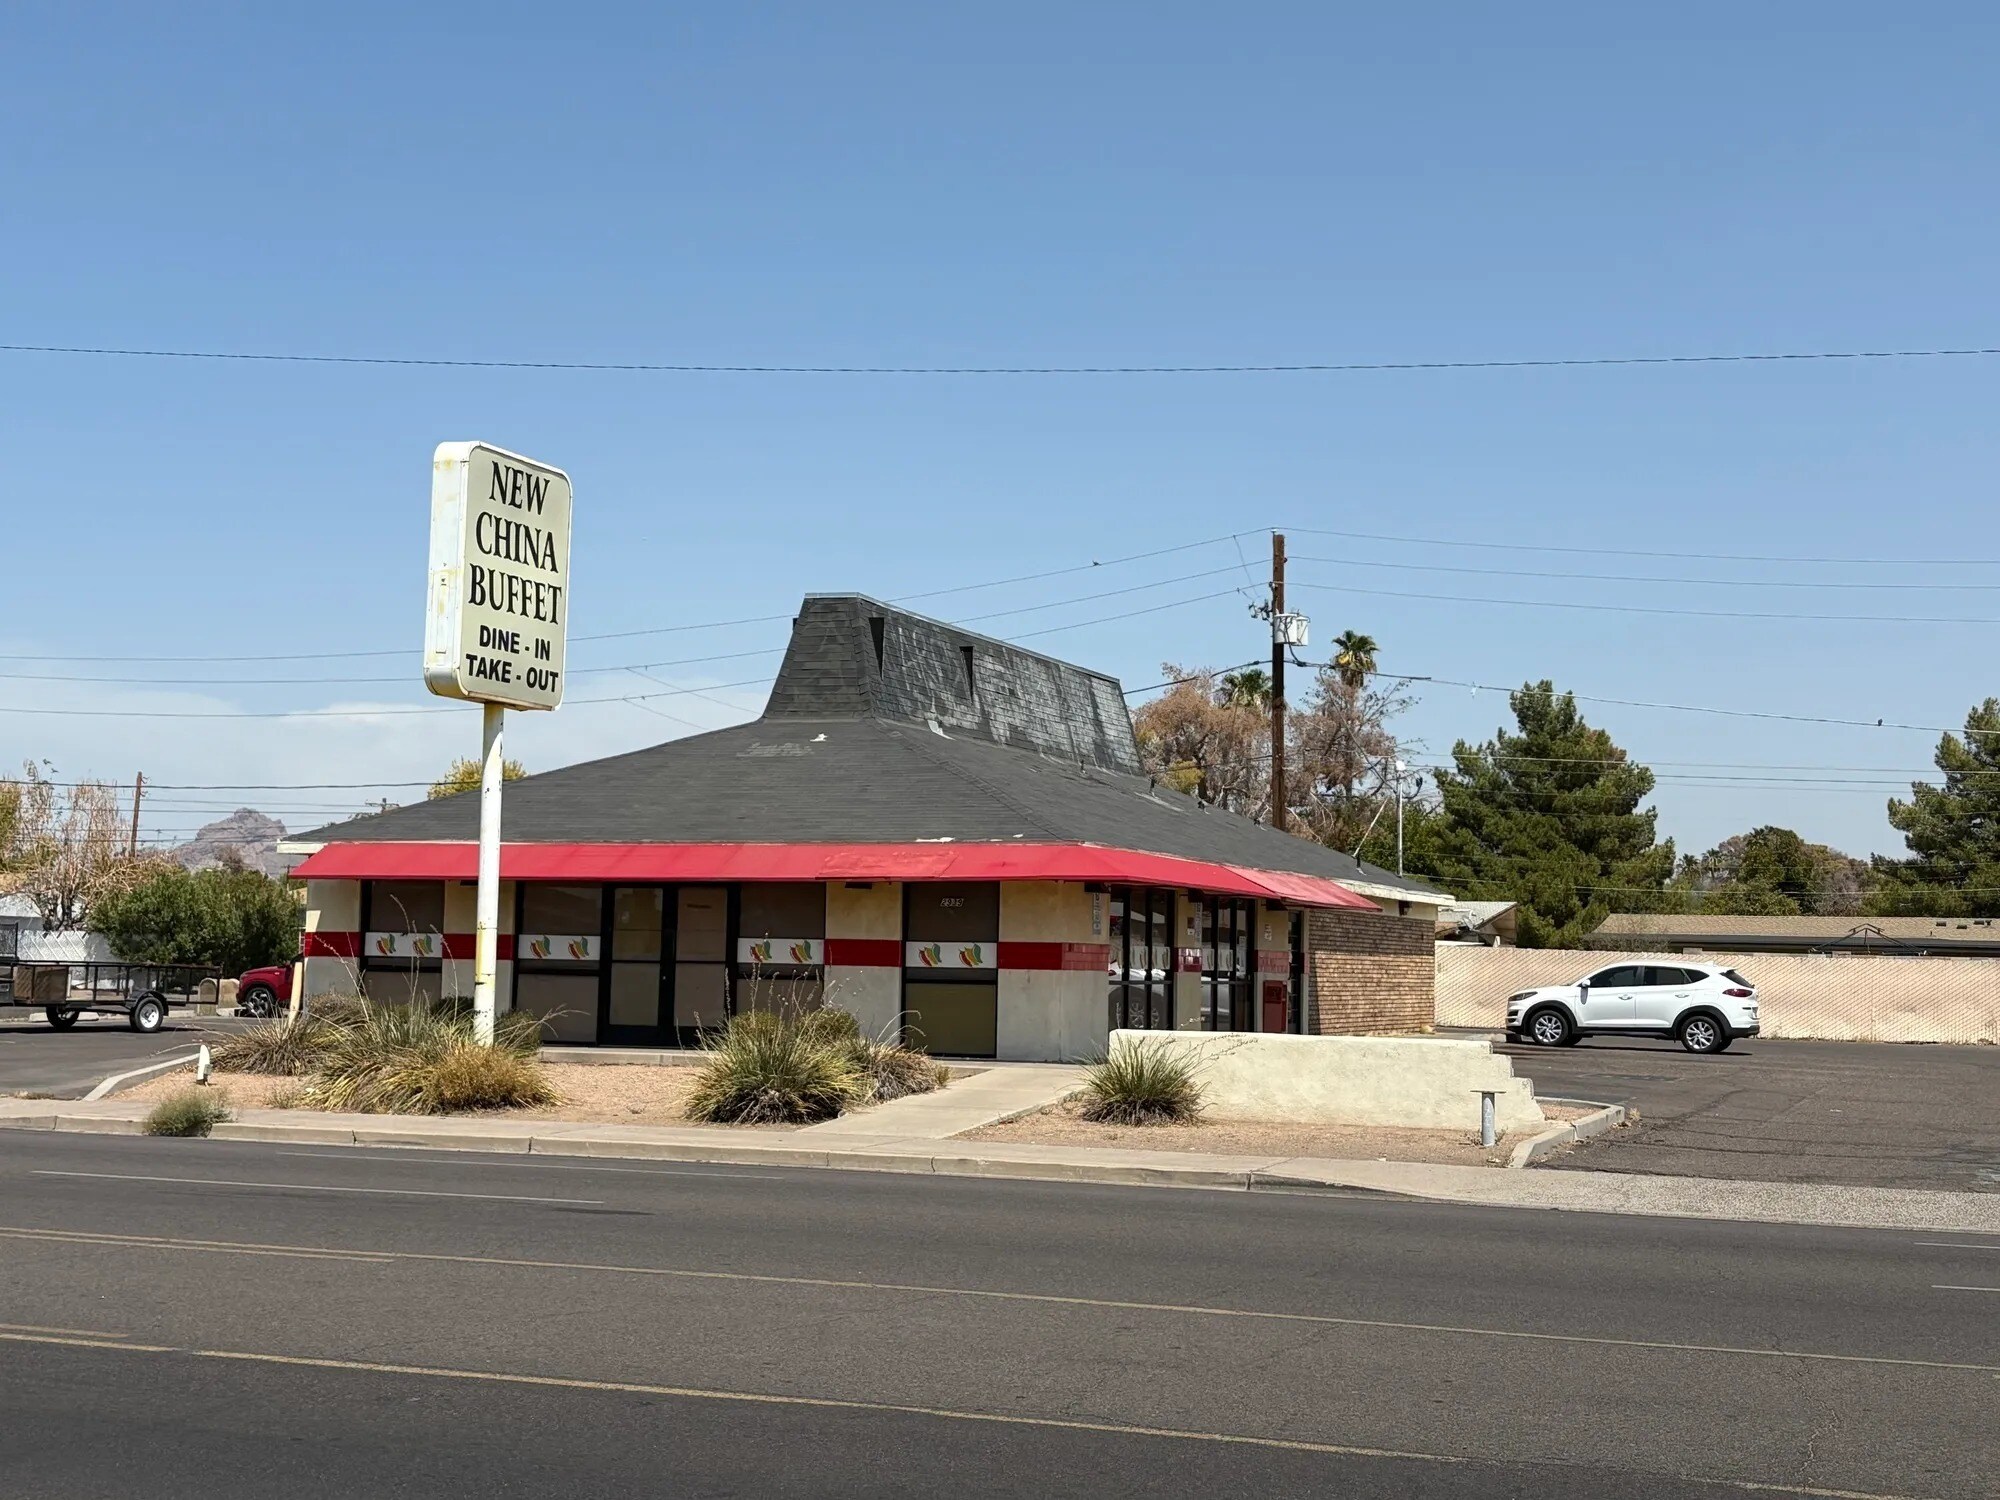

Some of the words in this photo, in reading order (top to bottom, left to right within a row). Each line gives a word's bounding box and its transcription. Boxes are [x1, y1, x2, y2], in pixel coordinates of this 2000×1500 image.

[489, 461, 550, 515] NEW
[475, 511, 558, 573] CHINA
[468, 563, 562, 625] BUFFET
[479, 625, 520, 655] DINE
[466, 654, 512, 683] TAKE
[526, 667, 559, 693] OUT
